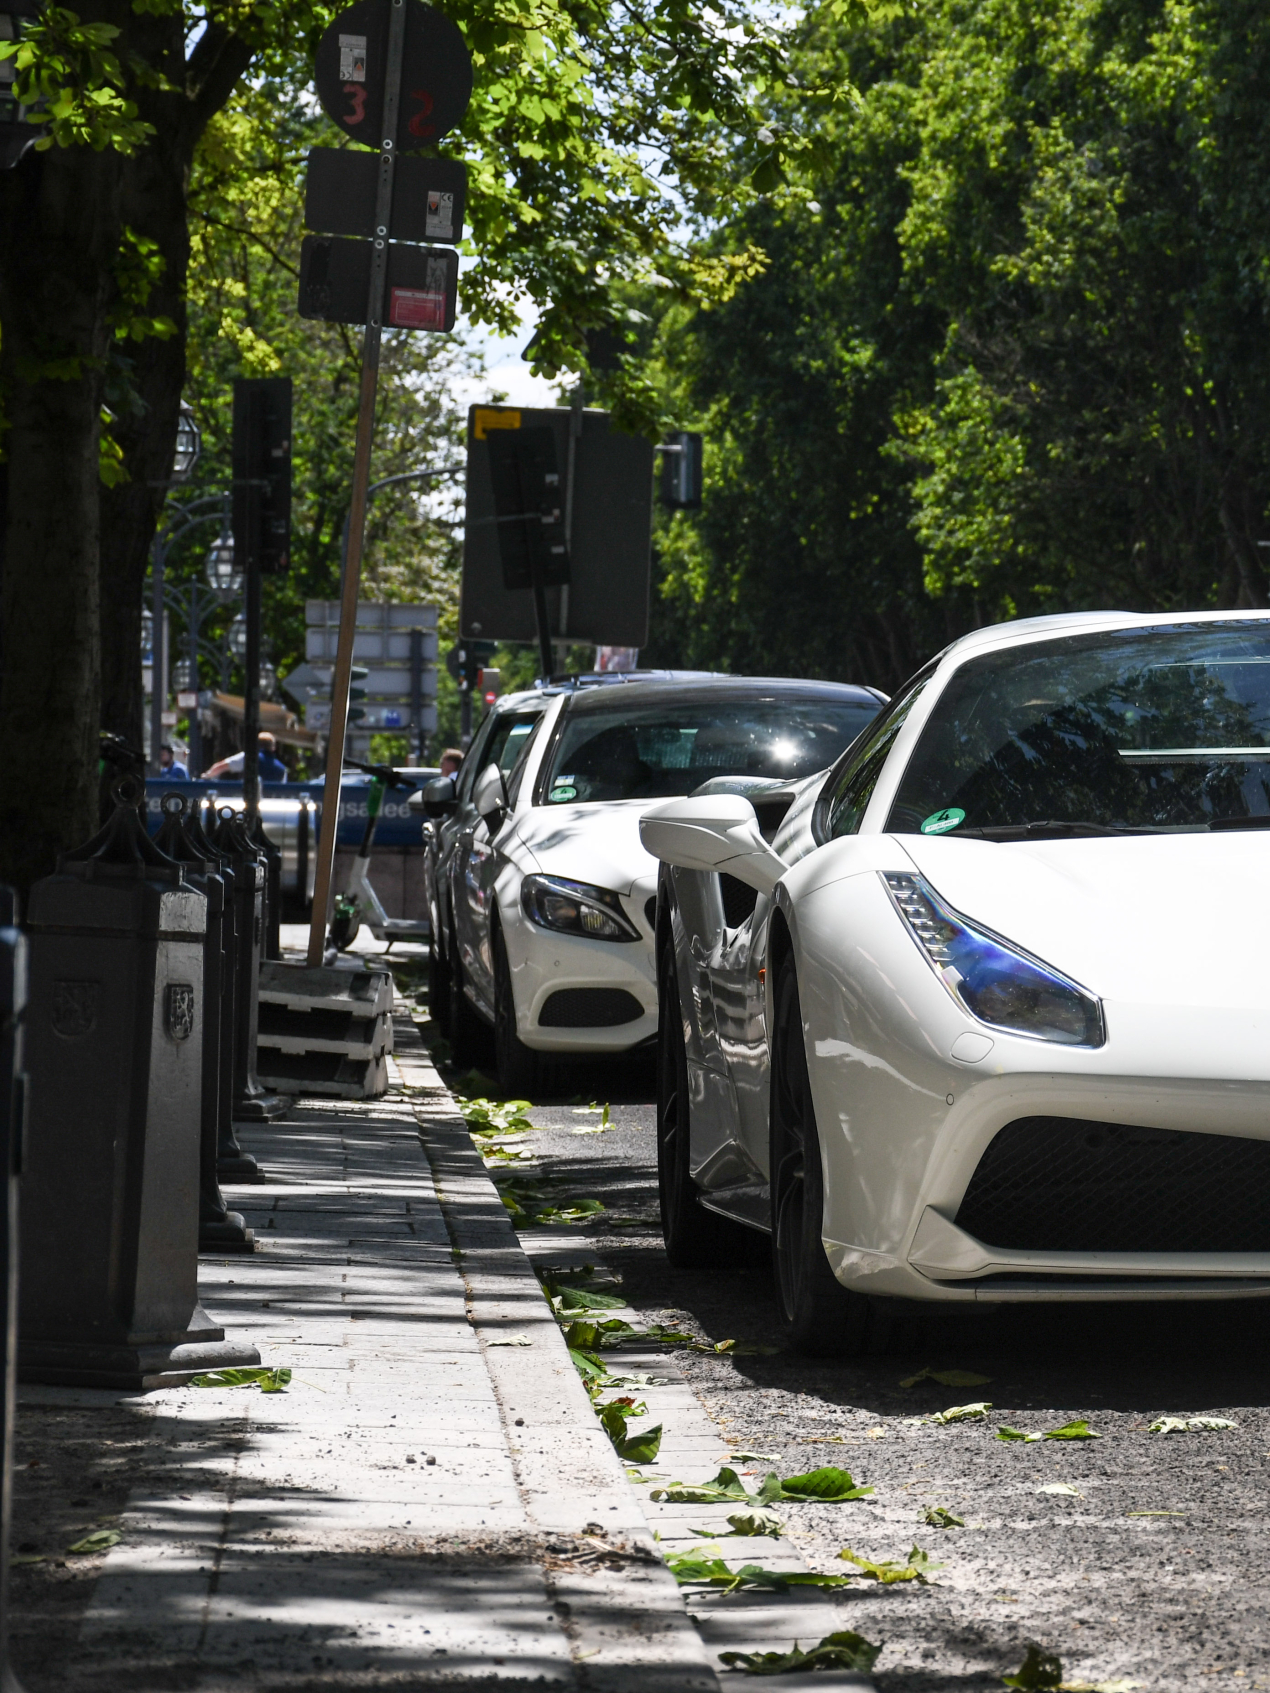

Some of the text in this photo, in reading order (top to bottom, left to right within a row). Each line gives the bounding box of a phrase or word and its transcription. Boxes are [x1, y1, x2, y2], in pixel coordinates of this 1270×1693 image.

[342, 83, 368, 125] 3
[408, 89, 436, 137] 2
[937, 809, 950, 821] 4
